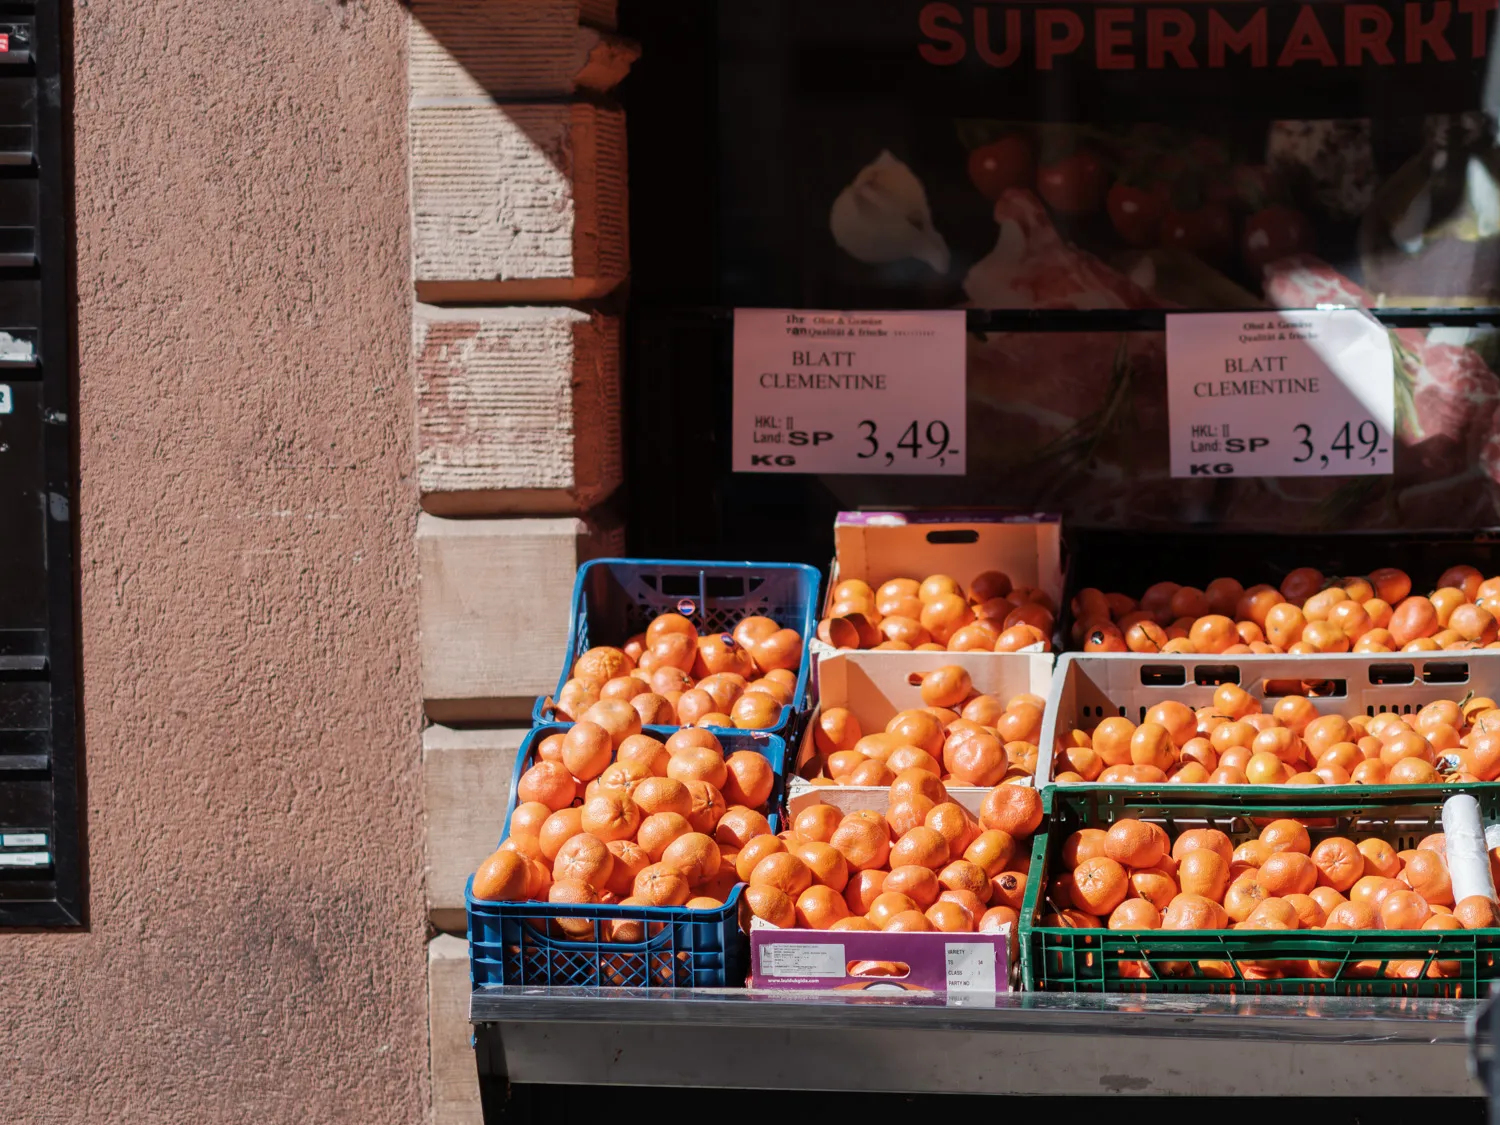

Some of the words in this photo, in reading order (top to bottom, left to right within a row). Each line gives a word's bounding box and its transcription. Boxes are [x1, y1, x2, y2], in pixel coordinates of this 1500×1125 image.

[917, 1, 1500, 70] SUPERMARKT
[1239, 332, 1276, 344] Qualität
[792, 350, 856, 367] BLATT
[1224, 356, 1288, 374] BLATT
[759, 373, 888, 390] CLEMENTINE
[1193, 377, 1320, 398] CLEMENTINE
[754, 415, 782, 429] HKL:
[753, 431, 785, 445] Land:
[787, 431, 835, 446] SP
[1191, 424, 1218, 438] HKL:
[1190, 440, 1222, 453] Land:
[1224, 438, 1270, 453] SP
[751, 454, 797, 467] KG
[1190, 462, 1234, 475] KG
